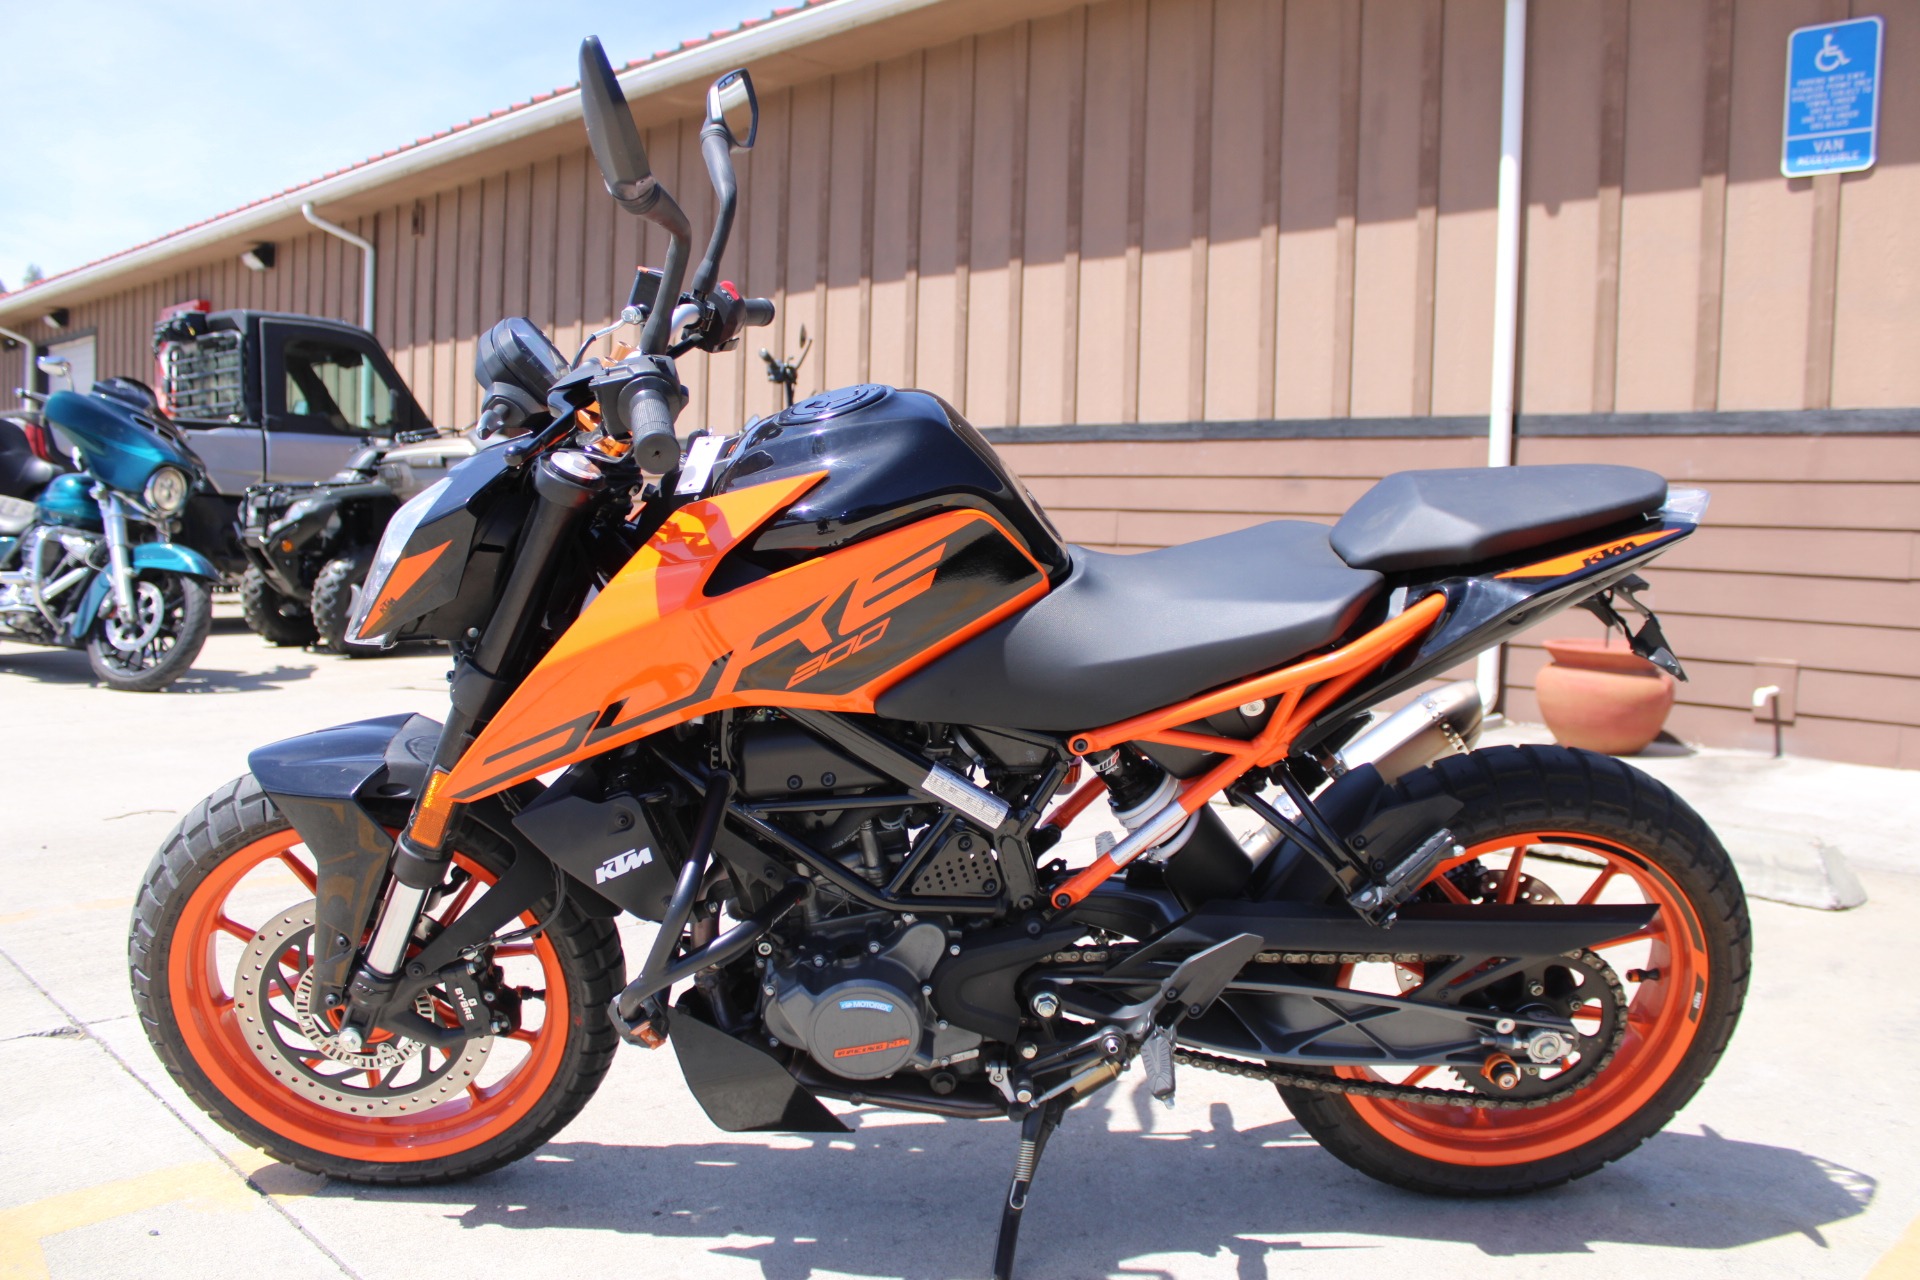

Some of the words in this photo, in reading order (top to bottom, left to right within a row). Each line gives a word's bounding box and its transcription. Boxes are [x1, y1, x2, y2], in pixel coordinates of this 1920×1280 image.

[1813, 137, 1845, 154] VAN
[785, 617, 891, 690] 200
[595, 847, 653, 885] KTM
[454, 987, 475, 1020] BYBRE
[853, 1001, 889, 1012] MOTOREX
